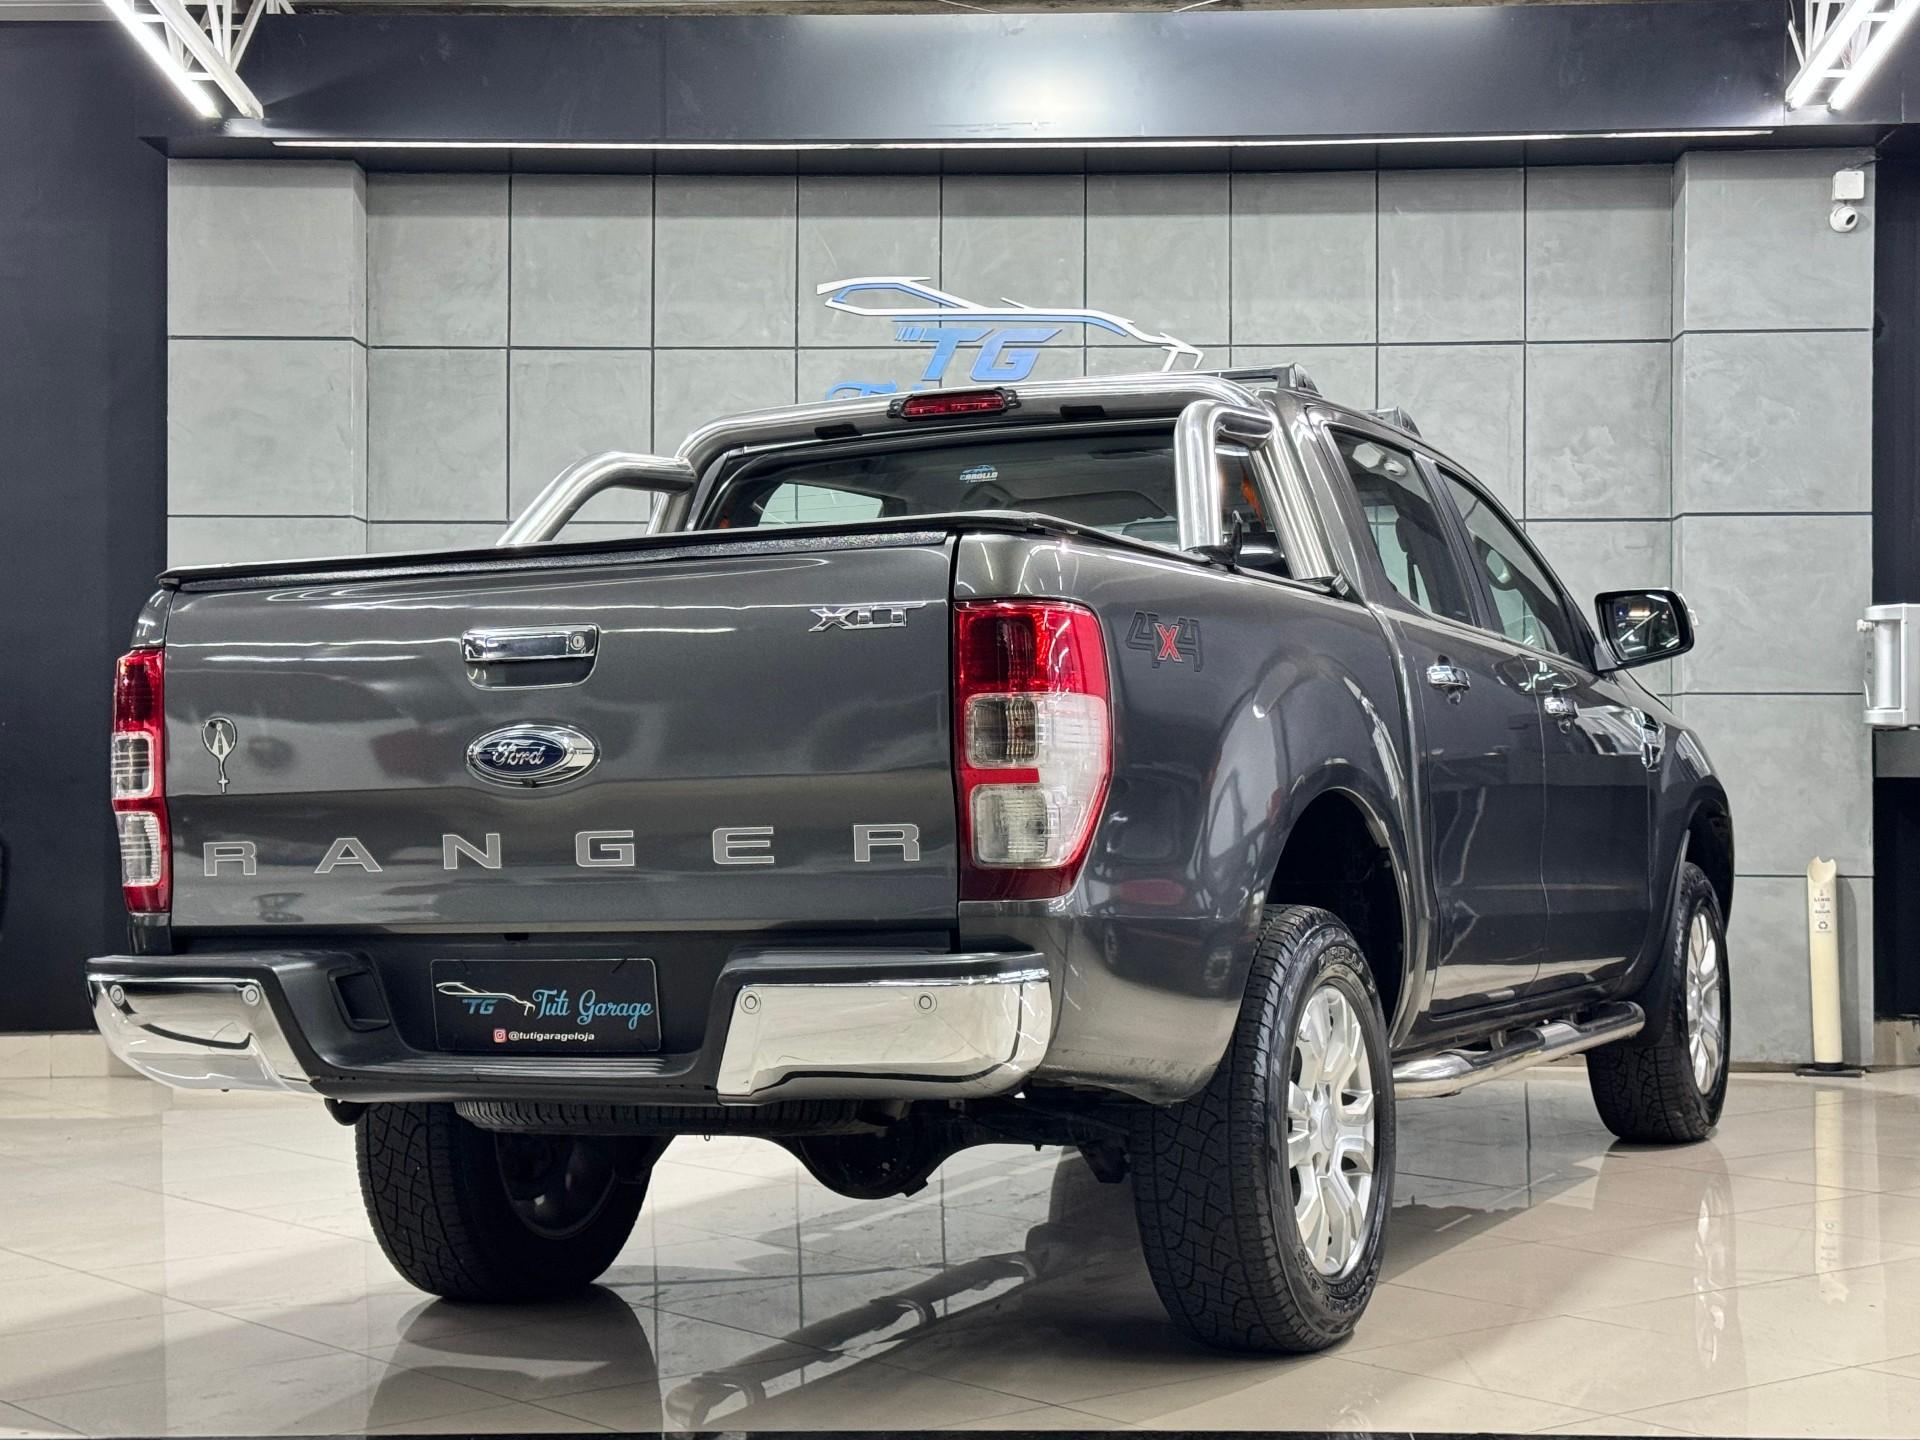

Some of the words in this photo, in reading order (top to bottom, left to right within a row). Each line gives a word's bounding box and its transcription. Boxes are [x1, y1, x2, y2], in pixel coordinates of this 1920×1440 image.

[918, 326, 1063, 382] TG
[808, 601, 927, 632] XLT
[491, 738, 547, 766] Ford
[203, 823, 920, 877] RANGER
[462, 997, 499, 1015] TG
[532, 988, 571, 1020] Tuti
[578, 988, 654, 1030] Garage
[508, 1030, 595, 1042] @tutigarageloja
